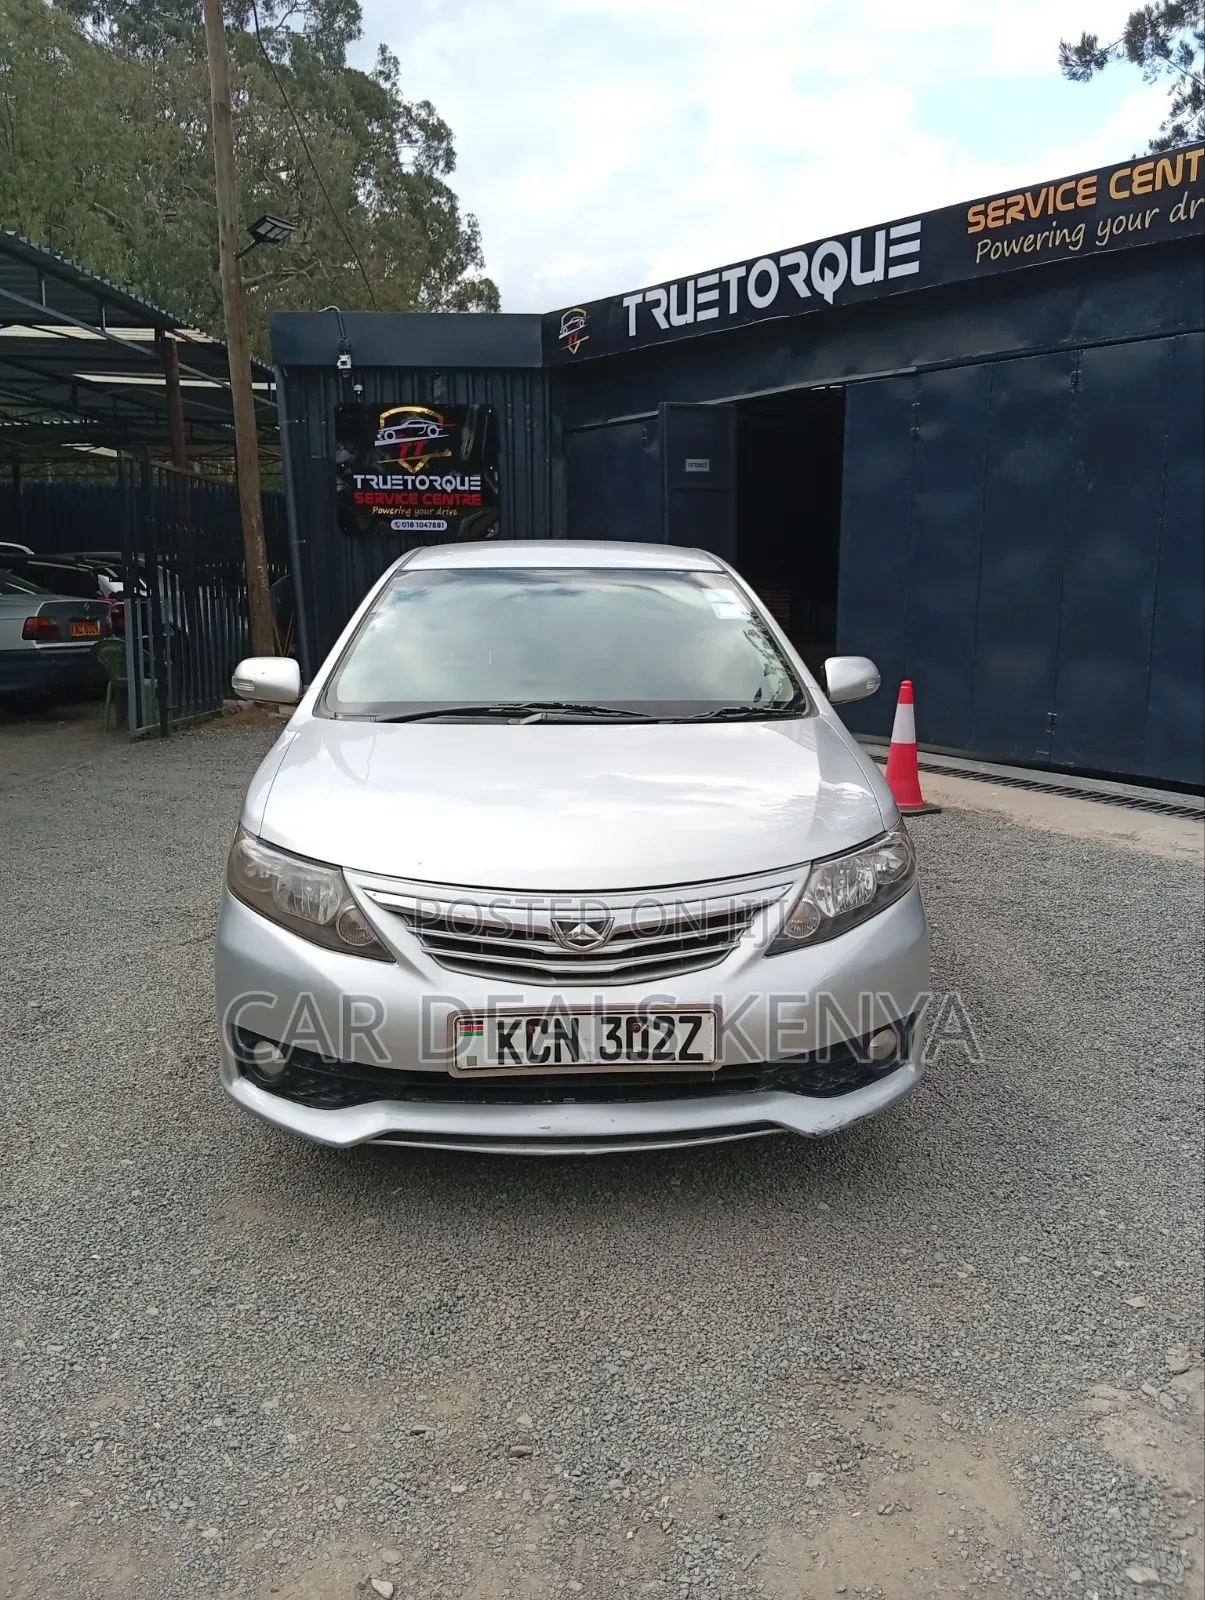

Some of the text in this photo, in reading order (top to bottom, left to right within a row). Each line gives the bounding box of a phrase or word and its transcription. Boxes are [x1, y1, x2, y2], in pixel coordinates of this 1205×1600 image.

[967, 175, 1098, 234] SERVICE
[975, 221, 1086, 264] Powering
[1096, 207, 1160, 246] your
[622, 220, 922, 337] TRUETORQUE
[399, 440, 429, 458] TT
[353, 474, 481, 493] TRUETORQUE
[354, 492, 482, 506] SERVICE CENTRE
[372, 506, 458, 516] Powering your drive
[402, 521, 445, 529] 018 1047881
[497, 1017, 579, 1065] KCN
[599, 1016, 704, 1062] 302Z
